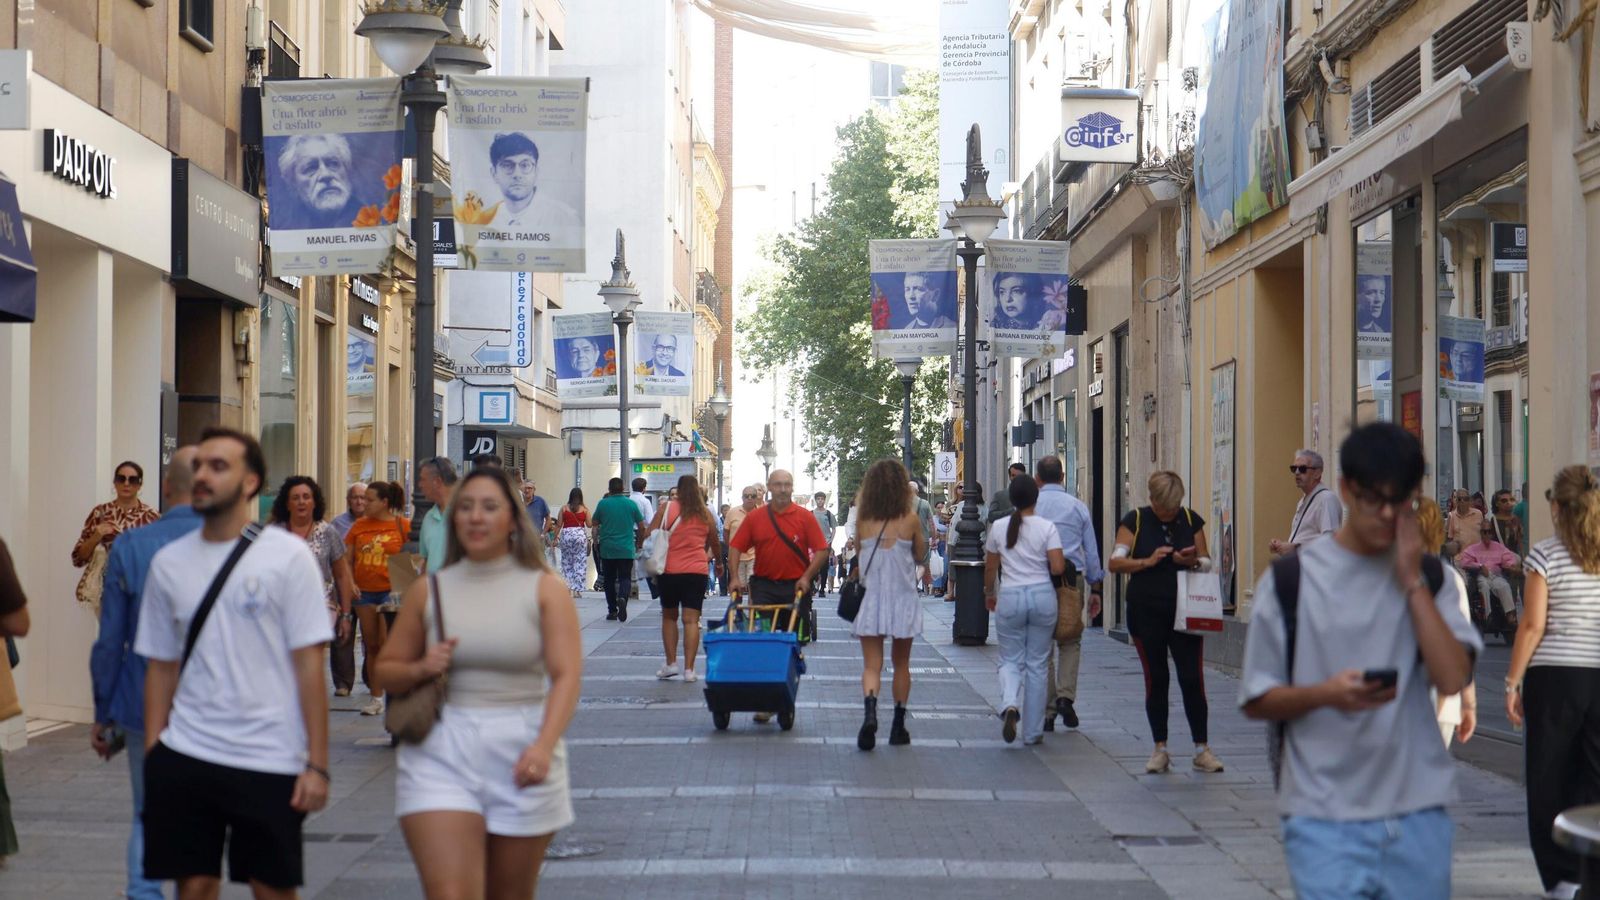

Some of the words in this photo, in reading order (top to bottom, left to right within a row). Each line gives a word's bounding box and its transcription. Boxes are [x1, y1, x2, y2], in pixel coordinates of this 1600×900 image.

[942, 34, 970, 42] Agencia
[971, 33, 1005, 41] Tributaria
[952, 42, 987, 50] Andalucía
[942, 51, 973, 59] Gerencia
[974, 50, 1009, 58] Provincial
[272, 107, 294, 120] Una
[296, 107, 316, 119] flor
[318, 104, 347, 118] abrió
[454, 102, 474, 113] Una
[477, 102, 496, 114] flor
[499, 102, 527, 114] abrió
[272, 120, 281, 130] el
[284, 118, 322, 131] asfalto
[465, 114, 502, 125] asfalto
[53, 127, 117, 200] PARFOIS
[196, 194, 222, 225] CENTRO
[225, 209, 255, 241] AUDITIVO
[306, 235, 347, 245] MANUEL
[349, 233, 377, 243] RIVAS
[478, 232, 513, 241] ISMAEL
[515, 232, 550, 242] RAMOS
[469, 437, 494, 455] JD
[646, 464, 671, 472] ONCE
